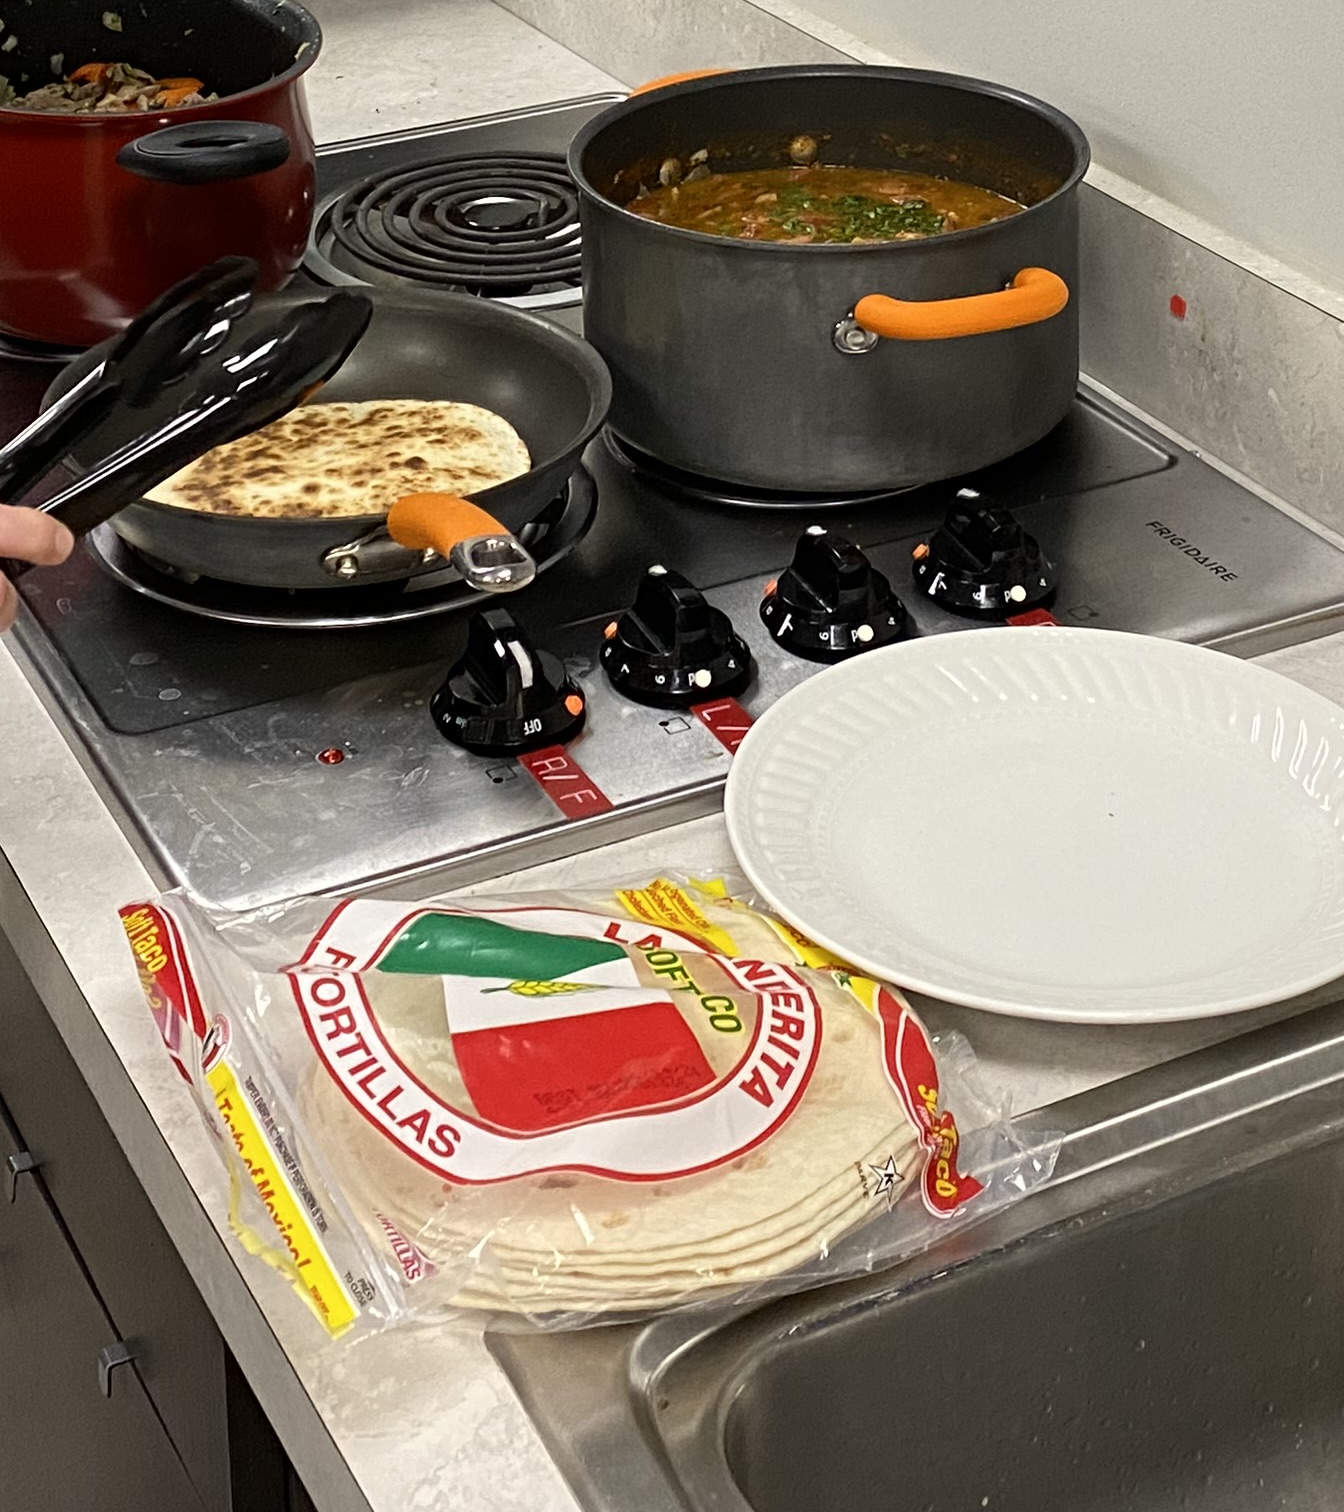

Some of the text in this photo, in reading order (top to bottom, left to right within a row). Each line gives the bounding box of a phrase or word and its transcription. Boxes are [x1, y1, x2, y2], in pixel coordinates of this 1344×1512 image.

[1145, 521, 1238, 582] FRIGIDAIRE
[523, 718, 542, 736] OFF
[701, 704, 751, 746] L/
[132, 926, 168, 974] Taco
